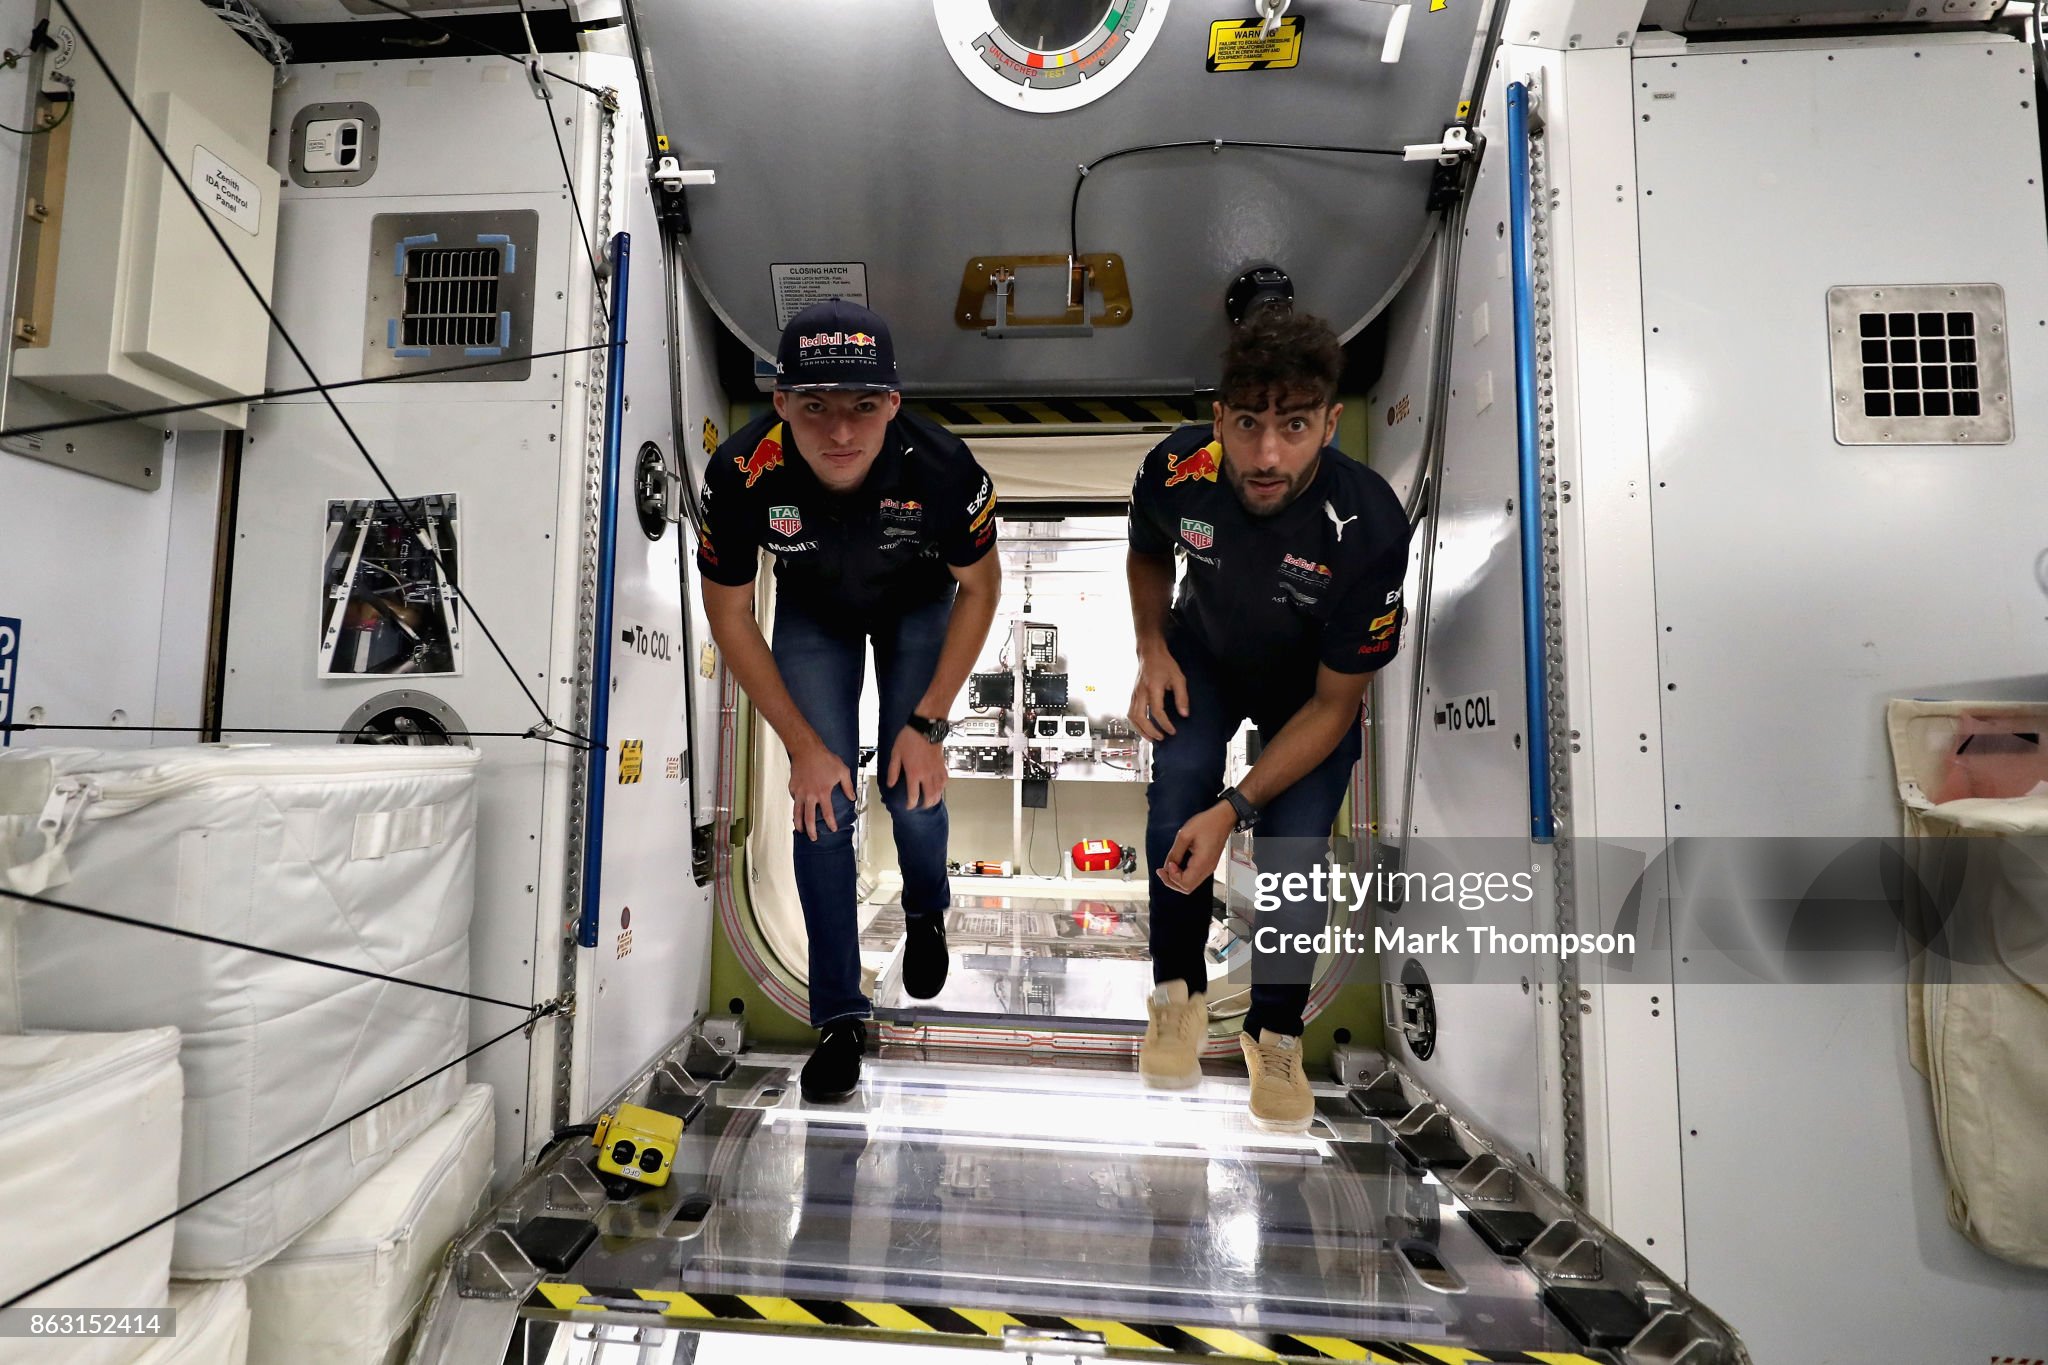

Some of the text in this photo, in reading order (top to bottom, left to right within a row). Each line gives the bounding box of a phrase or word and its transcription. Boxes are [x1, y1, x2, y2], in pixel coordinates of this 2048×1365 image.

[1234, 30, 1276, 39] WARNG
[989, 46, 1038, 77] UNLATCHED
[1044, 68, 1066, 78] TEST
[216, 170, 240, 191] Zenith
[206, 174, 247, 208] IDA Control
[216, 194, 236, 212] Panel
[800, 348, 877, 358] RACING
[772, 508, 799, 518] TAG
[772, 520, 801, 535] HEUER
[1184, 521, 1210, 534] TAG
[1183, 531, 1212, 547] HEUER
[768, 542, 807, 552] Mobil
[636, 625, 647, 655] To
[651, 630, 671, 661] COL
[1446, 696, 1496, 730] To COL
[623, 1168, 640, 1177] GFCI
